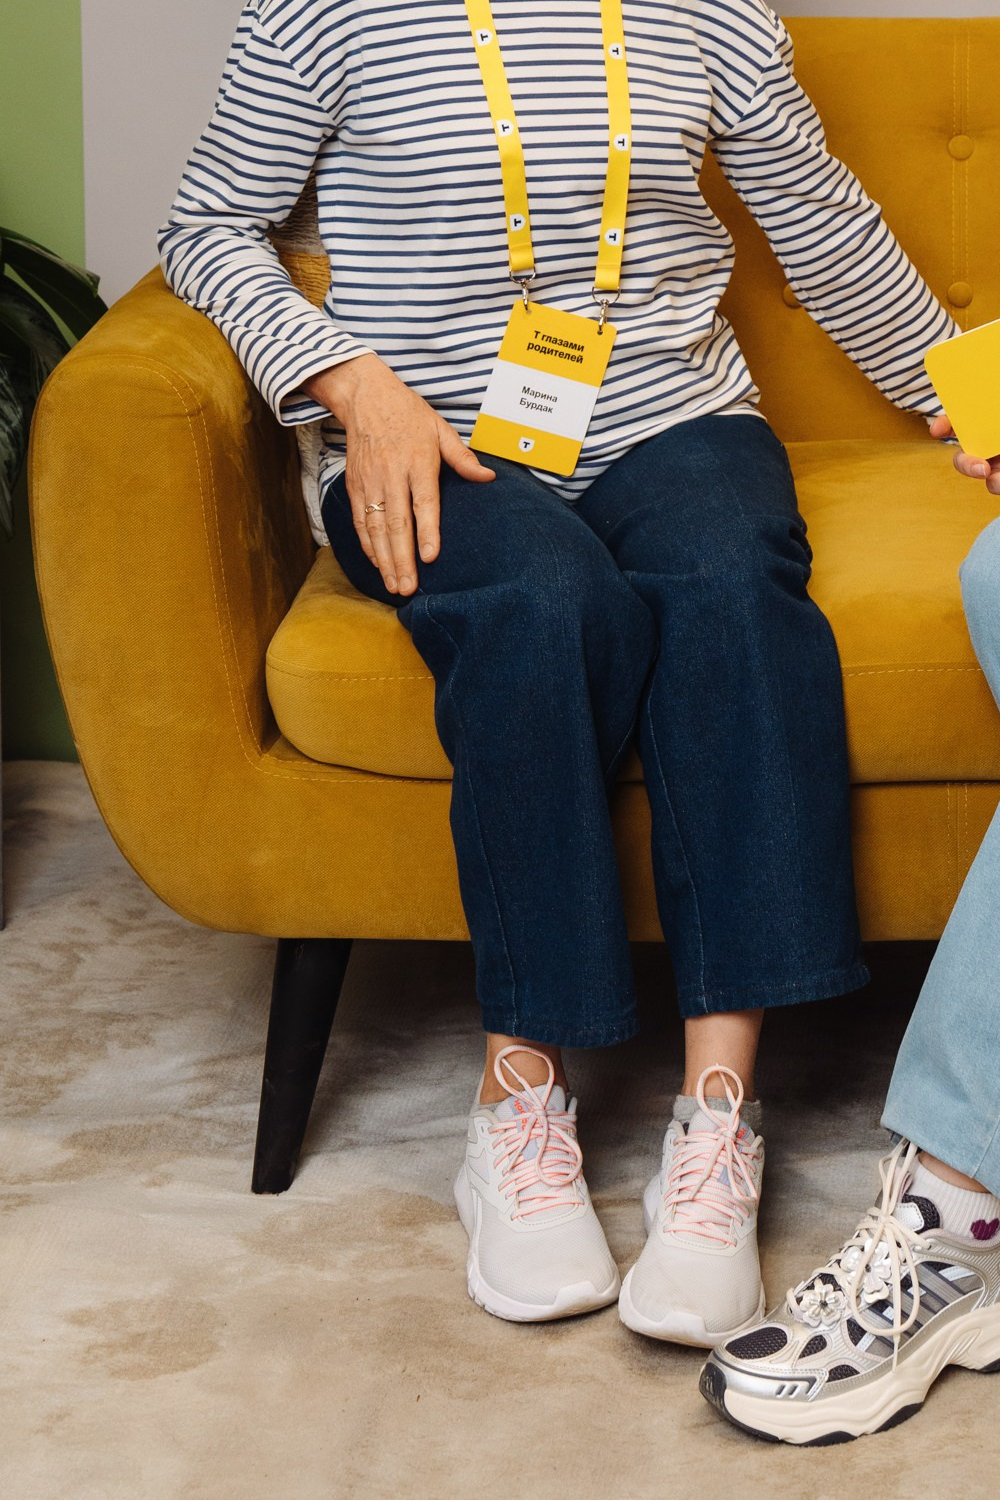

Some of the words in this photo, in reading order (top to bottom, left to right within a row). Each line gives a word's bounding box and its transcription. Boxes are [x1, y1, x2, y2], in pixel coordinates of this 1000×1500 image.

[534, 330, 540, 339] Т
[541, 334, 585, 353] глазами
[527, 342, 584, 364] родителей
[521, 386, 558, 403] Марина
[519, 397, 554, 414] Бурдак
